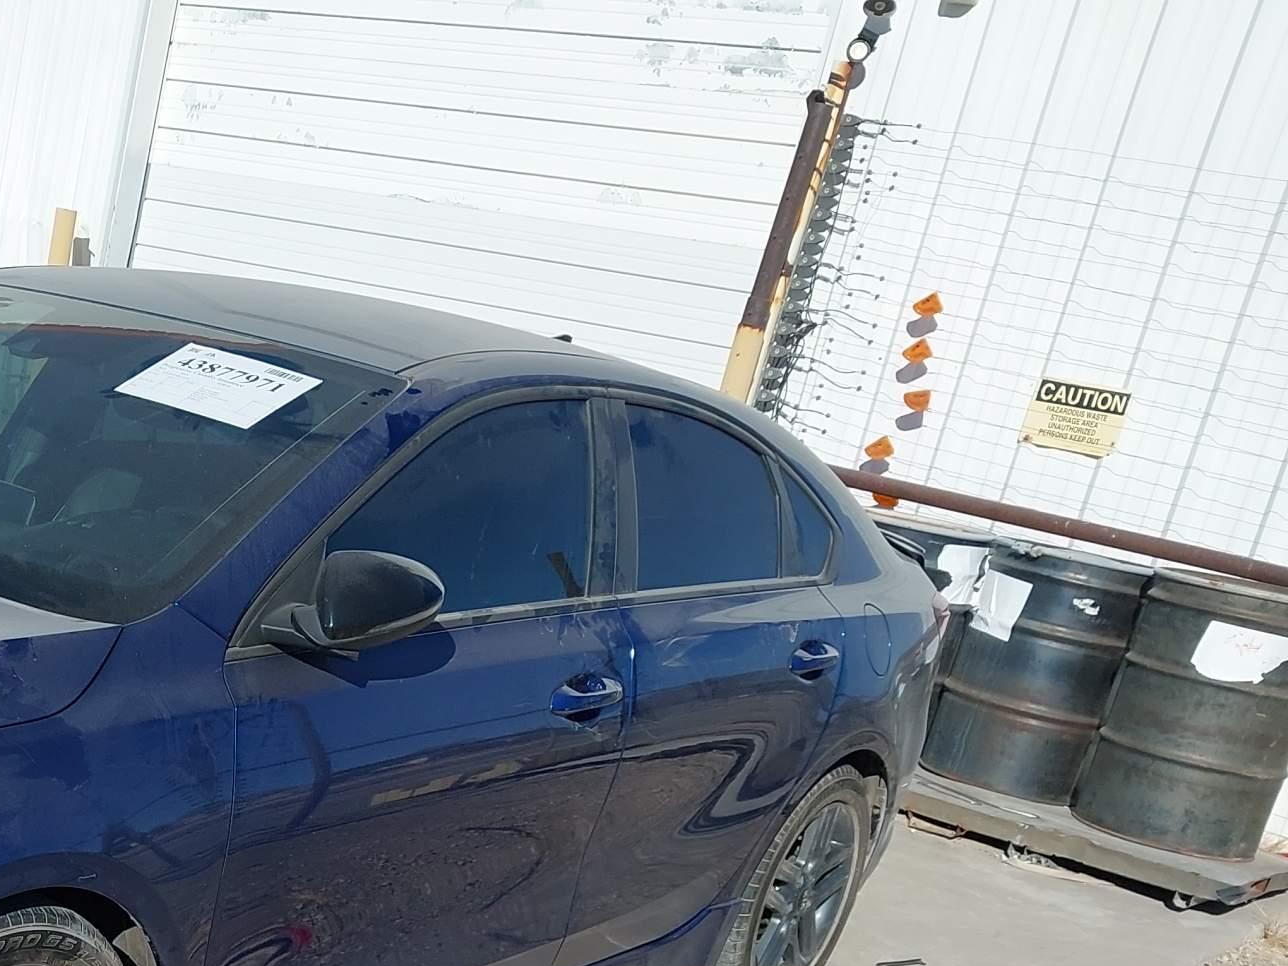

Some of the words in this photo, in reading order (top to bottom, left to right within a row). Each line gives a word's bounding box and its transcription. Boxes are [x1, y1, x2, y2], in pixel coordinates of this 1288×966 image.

[177, 357, 286, 393] 43877971
[1040, 382, 1128, 413] CAUTION
[1046, 405, 1086, 418] HAZARDOUS
[1086, 411, 1108, 422] WASTE
[1050, 414, 1080, 426] STORAGE
[1081, 420, 1099, 429] AREA
[1038, 428, 1068, 441] PERSONS
[1069, 434, 1087, 443] KEEP
[1087, 437, 1100, 446] OUT
[1048, 422, 1097, 437] UNAUTHORIZED
